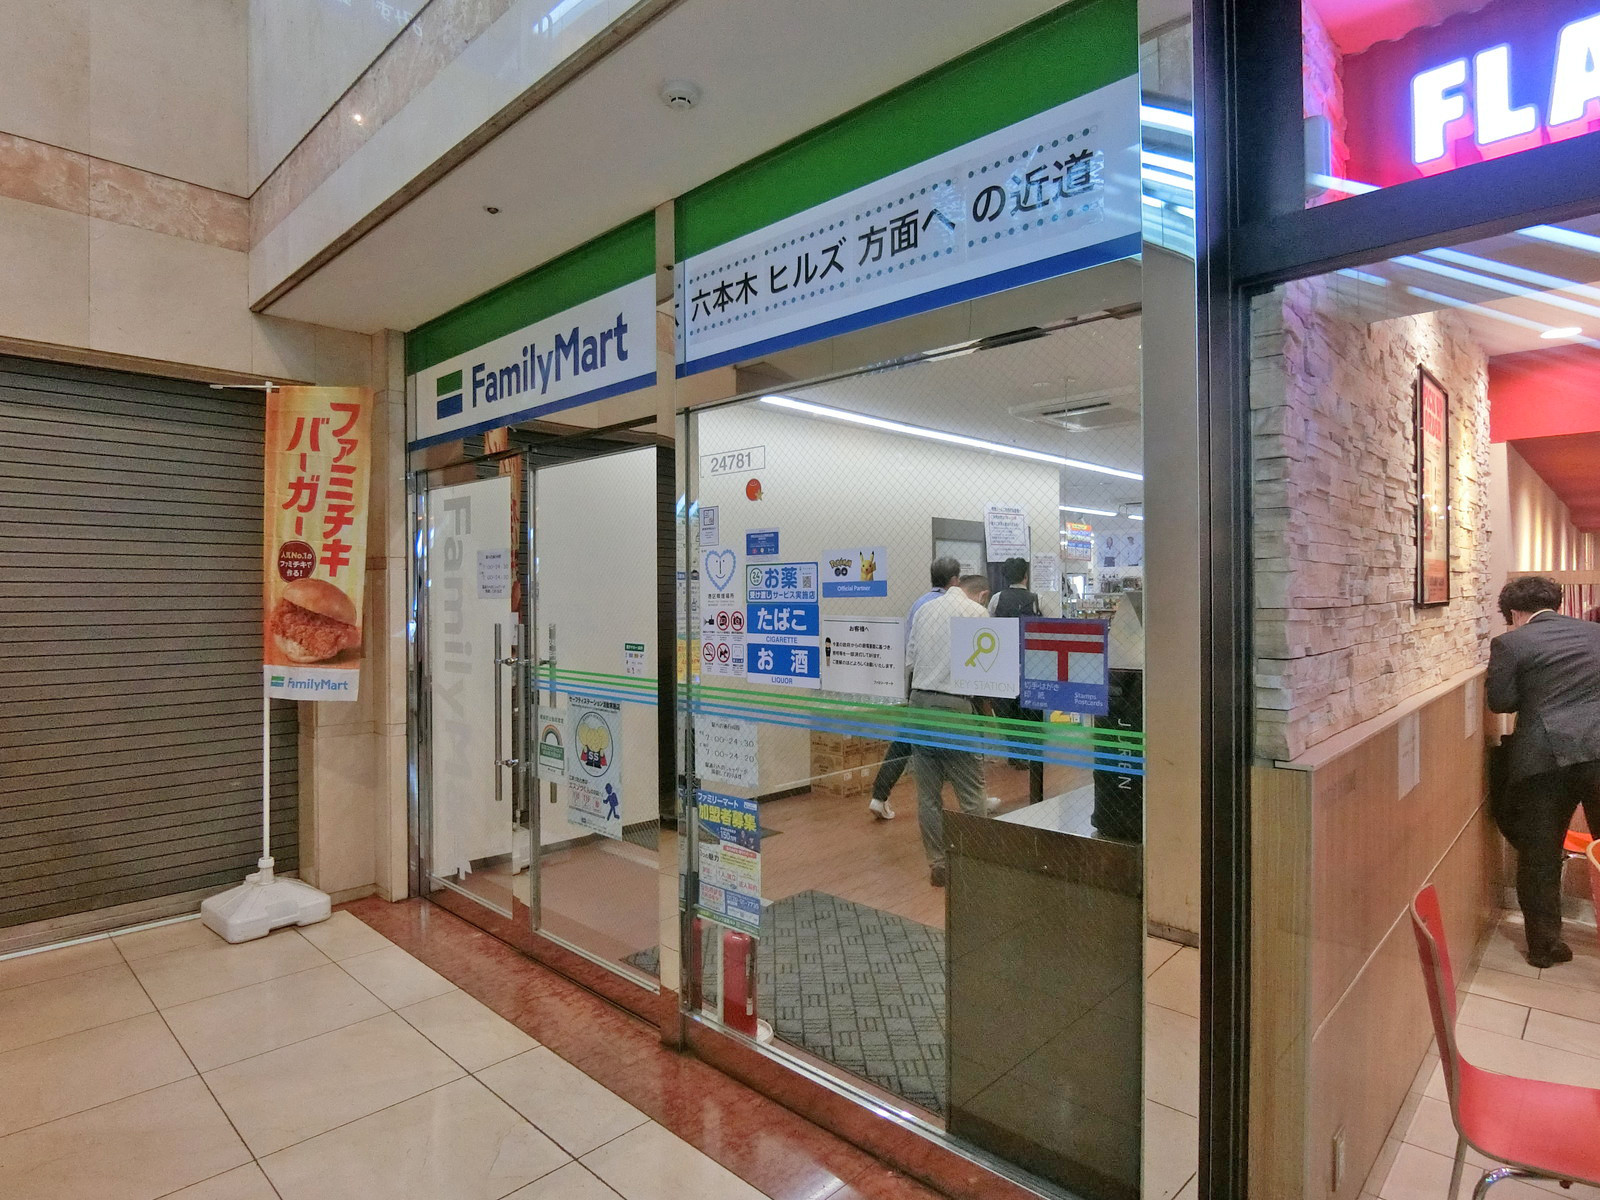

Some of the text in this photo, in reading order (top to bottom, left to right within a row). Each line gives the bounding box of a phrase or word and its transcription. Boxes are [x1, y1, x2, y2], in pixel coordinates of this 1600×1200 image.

[691, 272, 759, 322] 六本木
[769, 235, 847, 294] ヒルズ
[858, 208, 956, 267] 方面へ
[972, 149, 1094, 223] の近道
[472, 312, 629, 408] FamilyMart
[711, 452, 752, 473] 24781
[281, 417, 330, 537] バーガー
[320, 402, 361, 577] ファミチキ
[764, 566, 797, 589] お薬
[834, 567, 848, 577] GO
[757, 607, 807, 631] たばこ
[766, 635, 798, 644] CIGARETTE
[287, 677, 349, 691] FamilyMart
[771, 676, 793, 684] LIQUOR
[954, 680, 1015, 692] KEY STATION
[1074, 692, 1097, 700] Stamps
[1074, 699, 1104, 707] Postcards
[588, 751, 599, 761] SS
[698, 792, 739, 809] ファミリーマート
[698, 802, 757, 832] 加盟者募集
